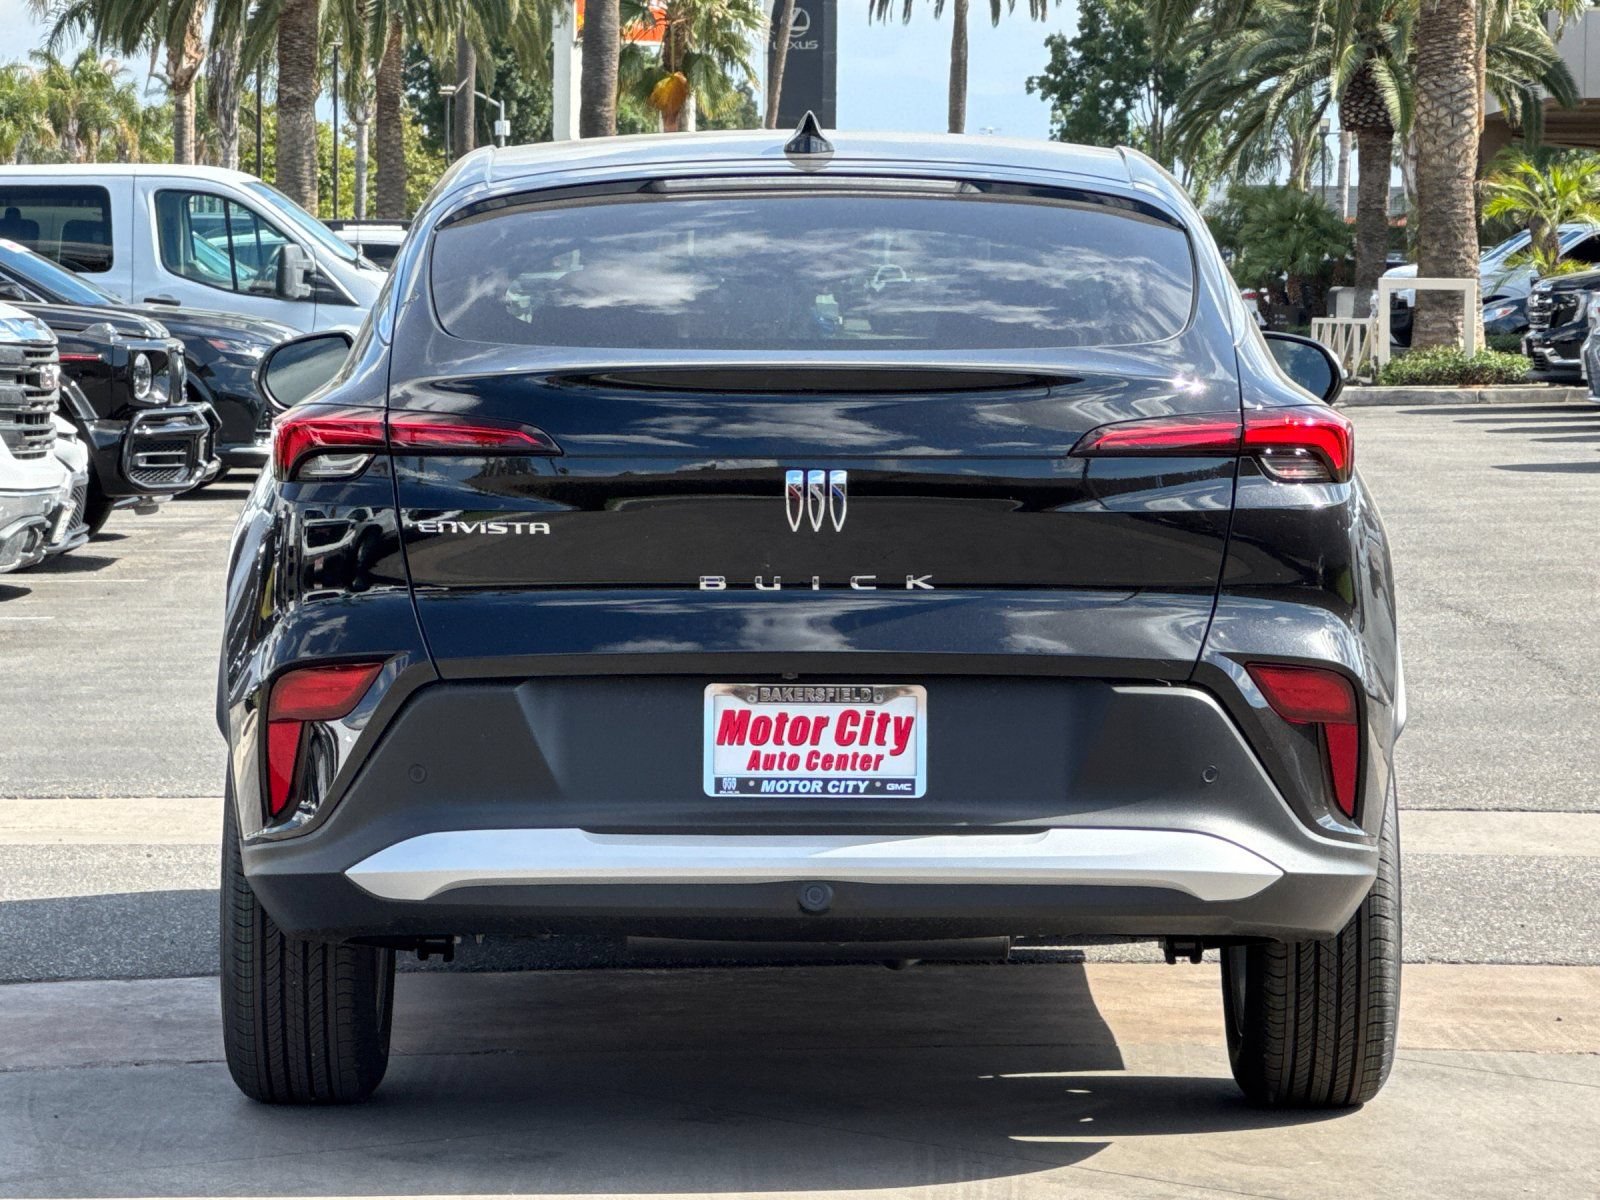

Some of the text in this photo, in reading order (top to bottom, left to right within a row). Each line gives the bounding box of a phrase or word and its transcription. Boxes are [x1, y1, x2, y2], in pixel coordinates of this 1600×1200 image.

[772, 40, 819, 49] LXUS
[417, 520, 551, 535] ENVISTA
[699, 574, 935, 591] BUICK
[758, 687, 873, 703] BAKERSFIELD
[716, 709, 915, 757] Motor City
[746, 749, 885, 772] Auto Center
[760, 780, 870, 794] MOTOR CITY
[886, 782, 913, 792] GMC
